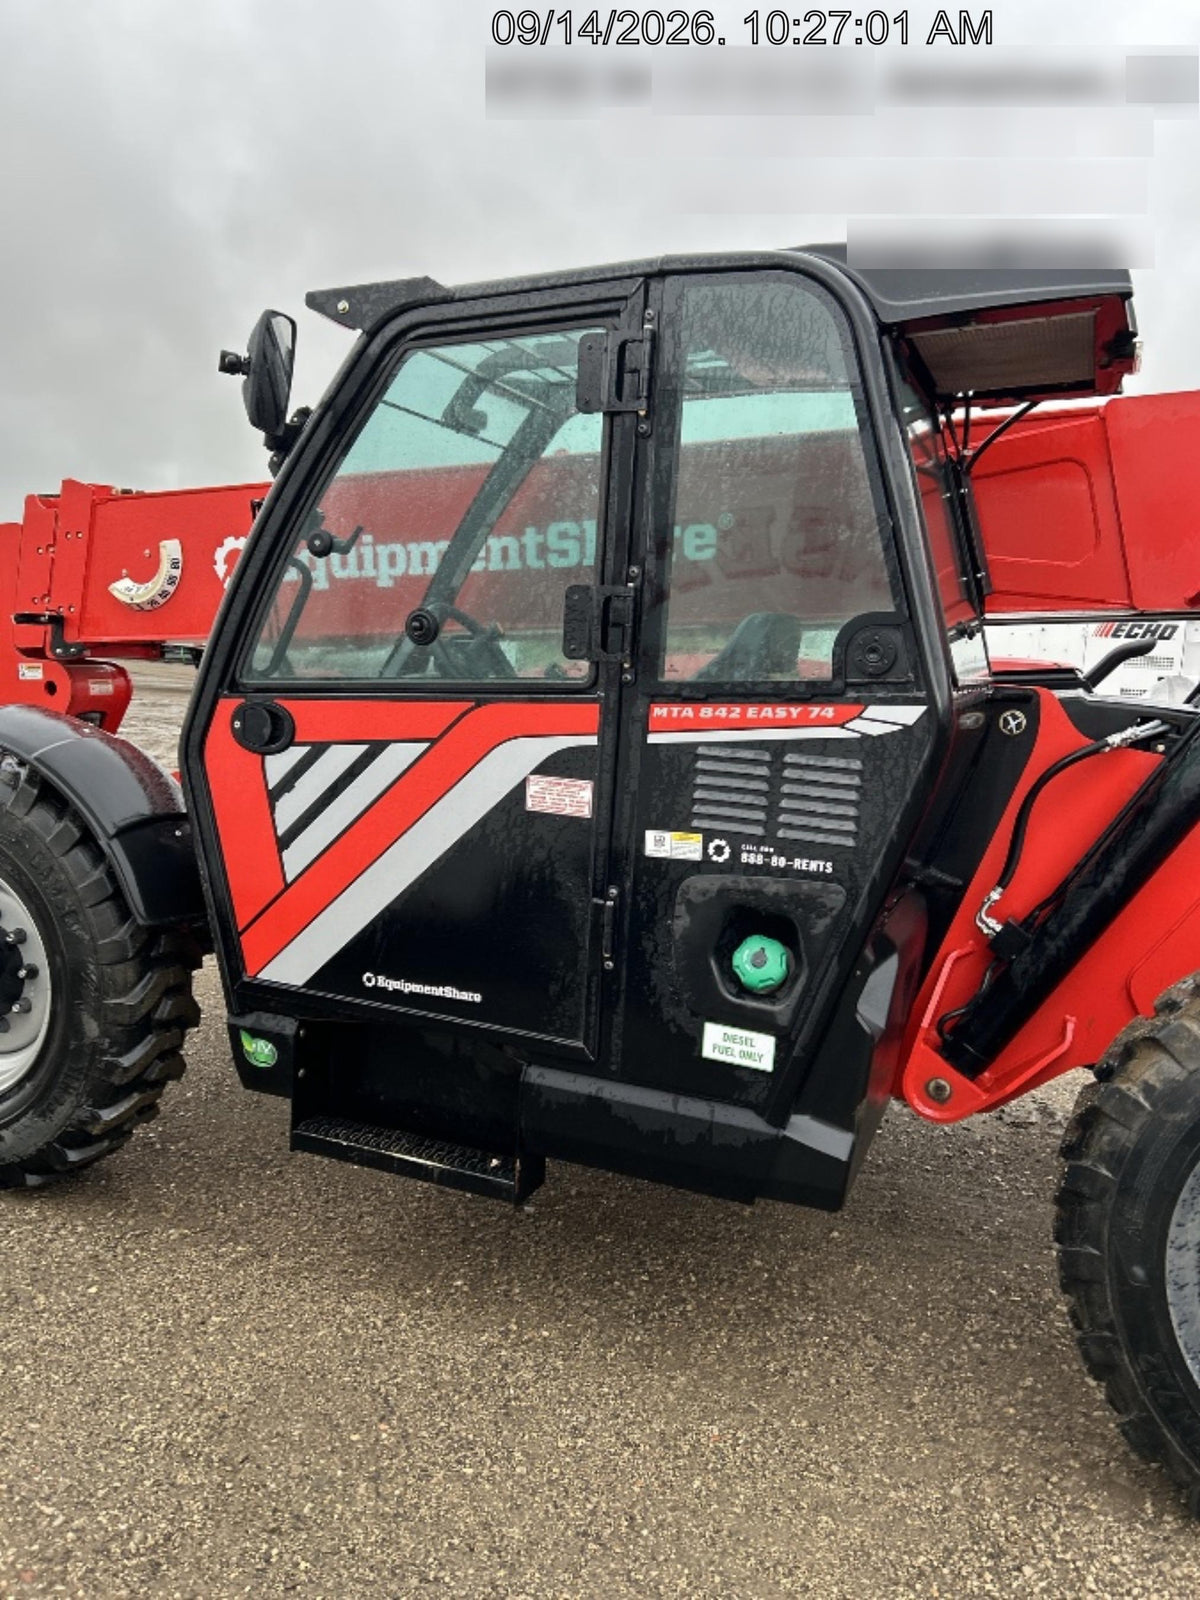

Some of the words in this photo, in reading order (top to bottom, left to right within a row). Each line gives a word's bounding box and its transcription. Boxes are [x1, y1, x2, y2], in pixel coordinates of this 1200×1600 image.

[1111, 623, 1180, 641] ECHO
[653, 706, 694, 719] MTA
[699, 706, 741, 719] 842
[746, 706, 803, 719] EASY
[808, 706, 835, 719] 74
[376, 975, 483, 1003] EquipmentShare
[722, 1032, 757, 1048] DIESEL
[712, 1043, 737, 1058] FUEL
[738, 1049, 764, 1064] ONLY
